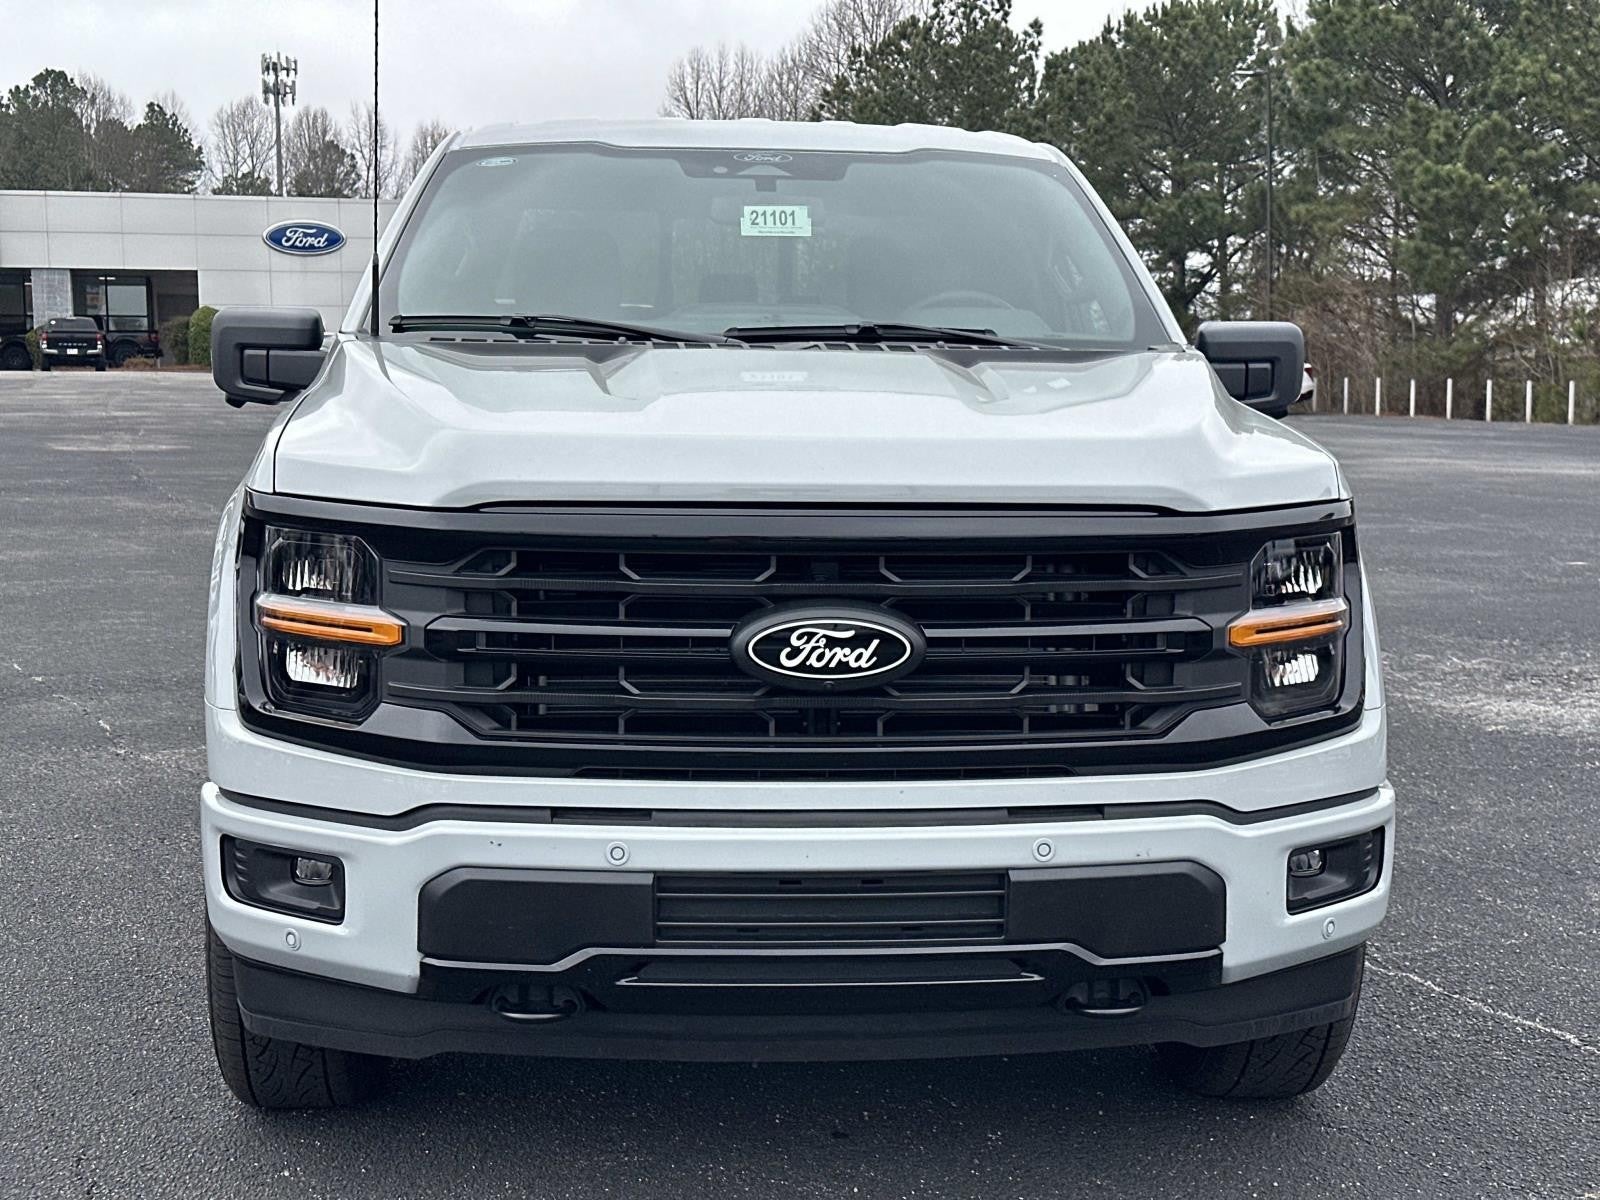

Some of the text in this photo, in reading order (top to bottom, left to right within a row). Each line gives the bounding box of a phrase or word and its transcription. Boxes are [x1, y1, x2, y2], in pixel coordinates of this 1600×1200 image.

[750, 209, 795, 227] 21101
[281, 227, 329, 247] Ford
[779, 627, 881, 669] Ford
